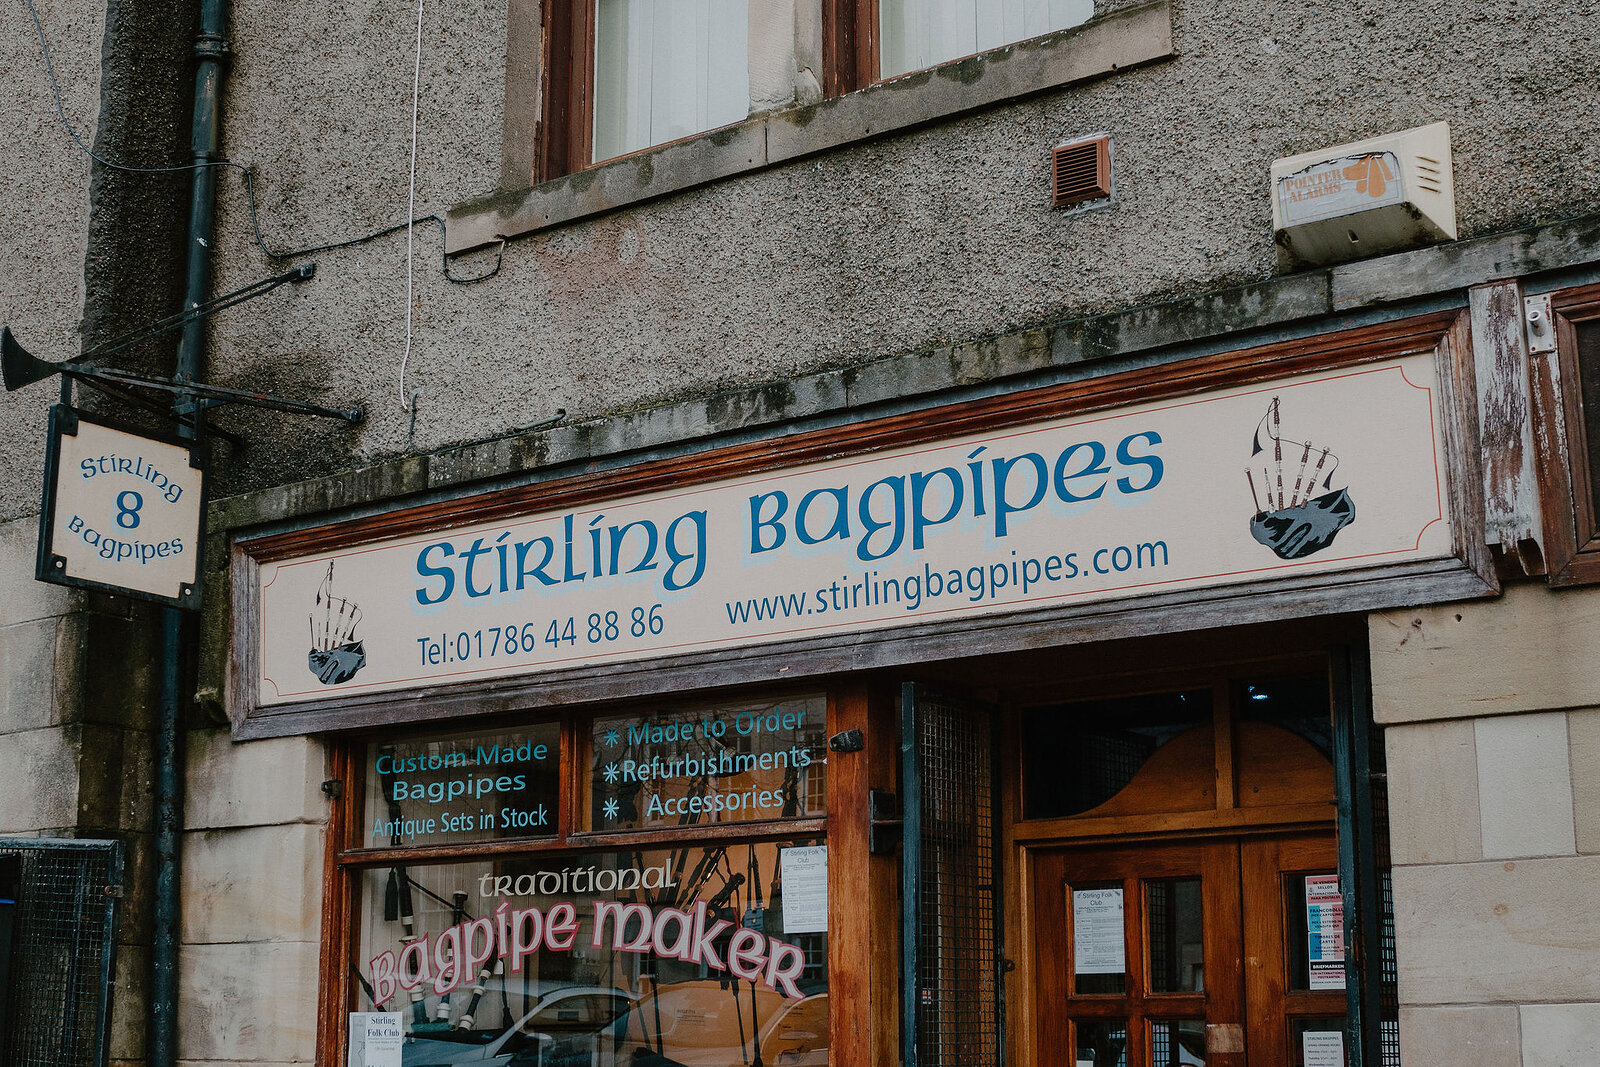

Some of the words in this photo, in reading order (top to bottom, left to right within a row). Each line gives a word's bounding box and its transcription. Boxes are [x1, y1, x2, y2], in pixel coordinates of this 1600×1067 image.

[1286, 169, 1341, 191] POINTER
[1291, 183, 1342, 202] ALARMS
[116, 490, 144, 529] 8
[726, 536, 1169, 625] www.stirlingbagpipes.com
[545, 616, 577, 649] 44
[587, 610, 620, 644] 88
[630, 603, 664, 638] 86
[628, 717, 694, 746] Made
[702, 717, 726, 738] to
[735, 706, 806, 735] Order
[375, 752, 466, 775] Custom
[476, 739, 548, 766] Made
[623, 745, 811, 783] Refurbishments
[393, 773, 526, 804] Bagpipes
[646, 784, 784, 817] Accessories
[372, 815, 436, 840] Antique
[440, 812, 474, 833] Sets
[479, 808, 495, 830] in
[501, 803, 548, 829] Stock
[367, 1029, 383, 1037] Folk
[384, 1028, 400, 1037] Club
[370, 1016, 396, 1025] Stirling
